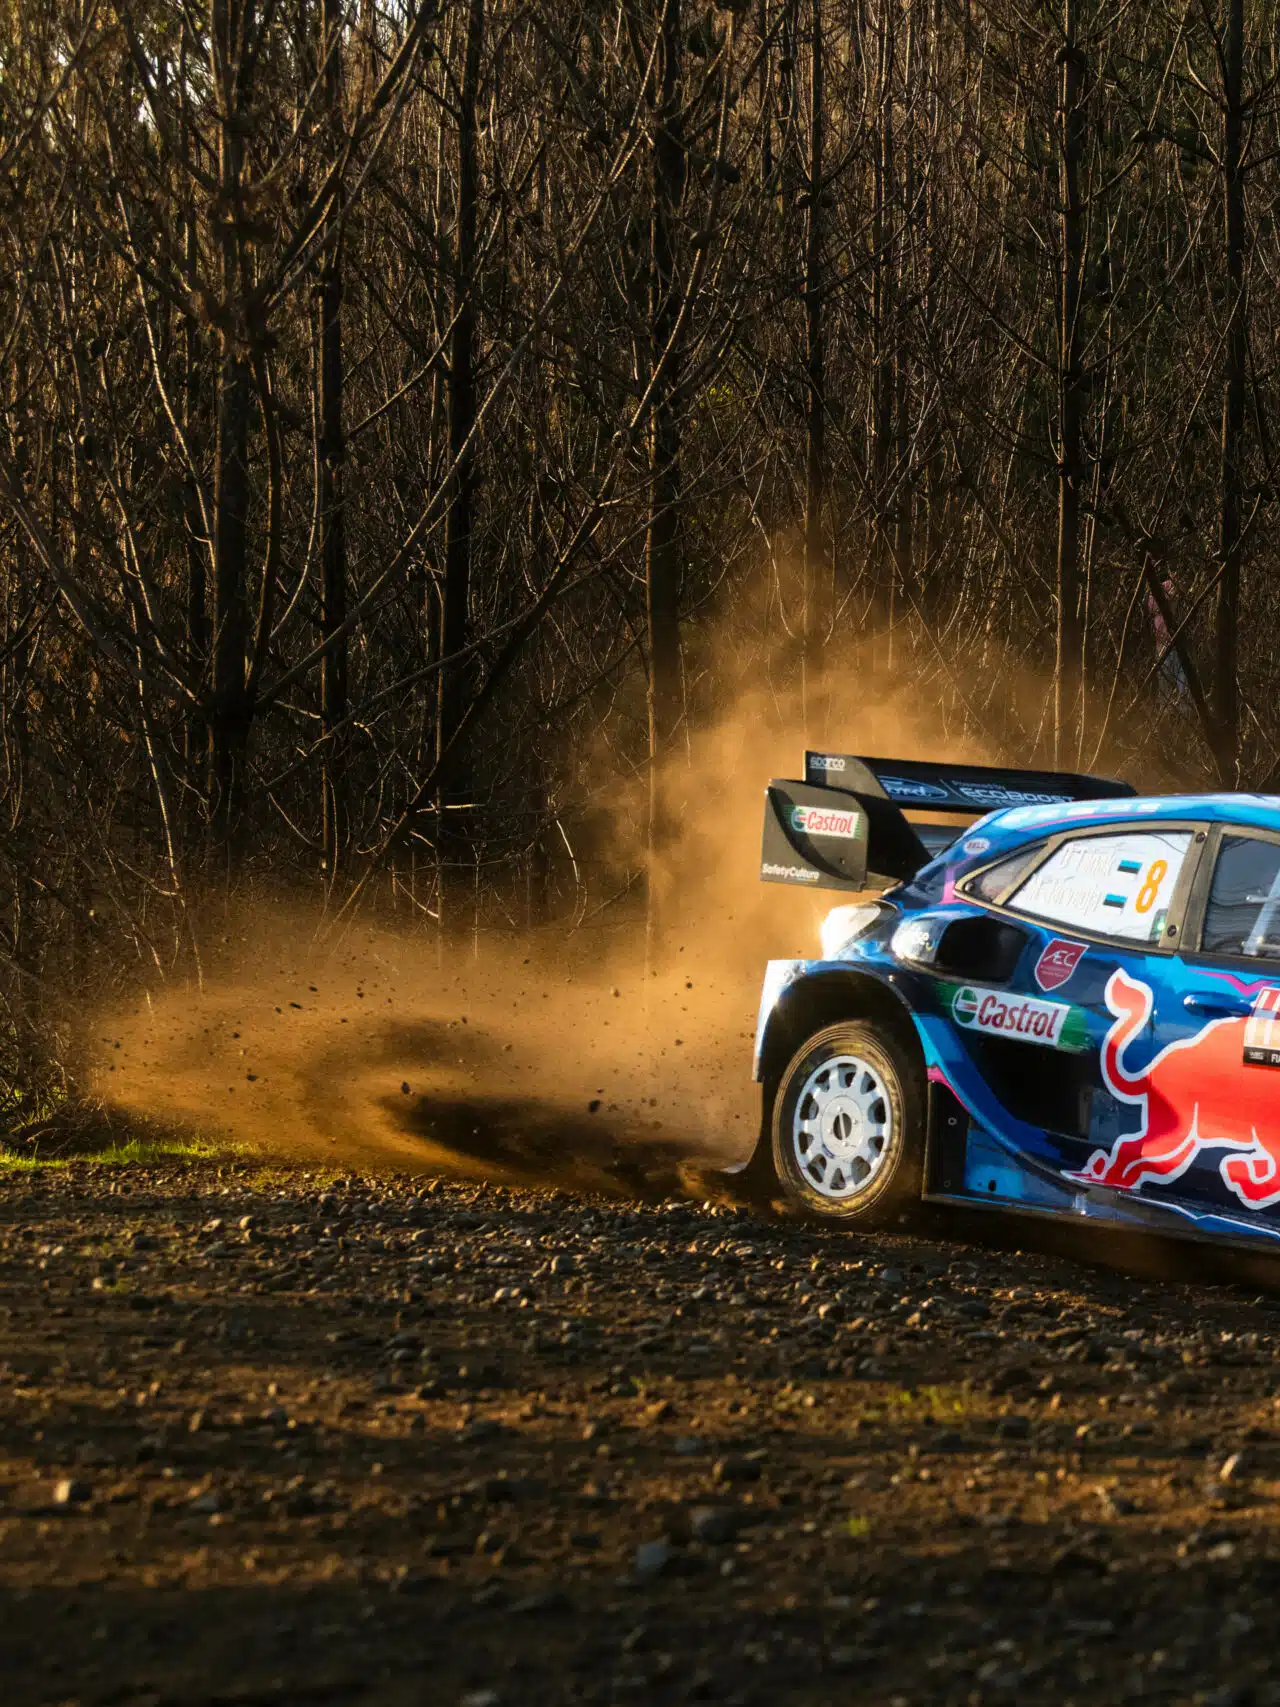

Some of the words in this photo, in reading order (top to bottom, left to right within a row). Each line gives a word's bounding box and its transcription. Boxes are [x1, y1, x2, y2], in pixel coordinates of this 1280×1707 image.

[807, 810, 855, 834] Castrol
[762, 863, 820, 879] SafetyCulture
[1135, 859, 1168, 914] 8
[977, 995, 1060, 1039] Castrol
